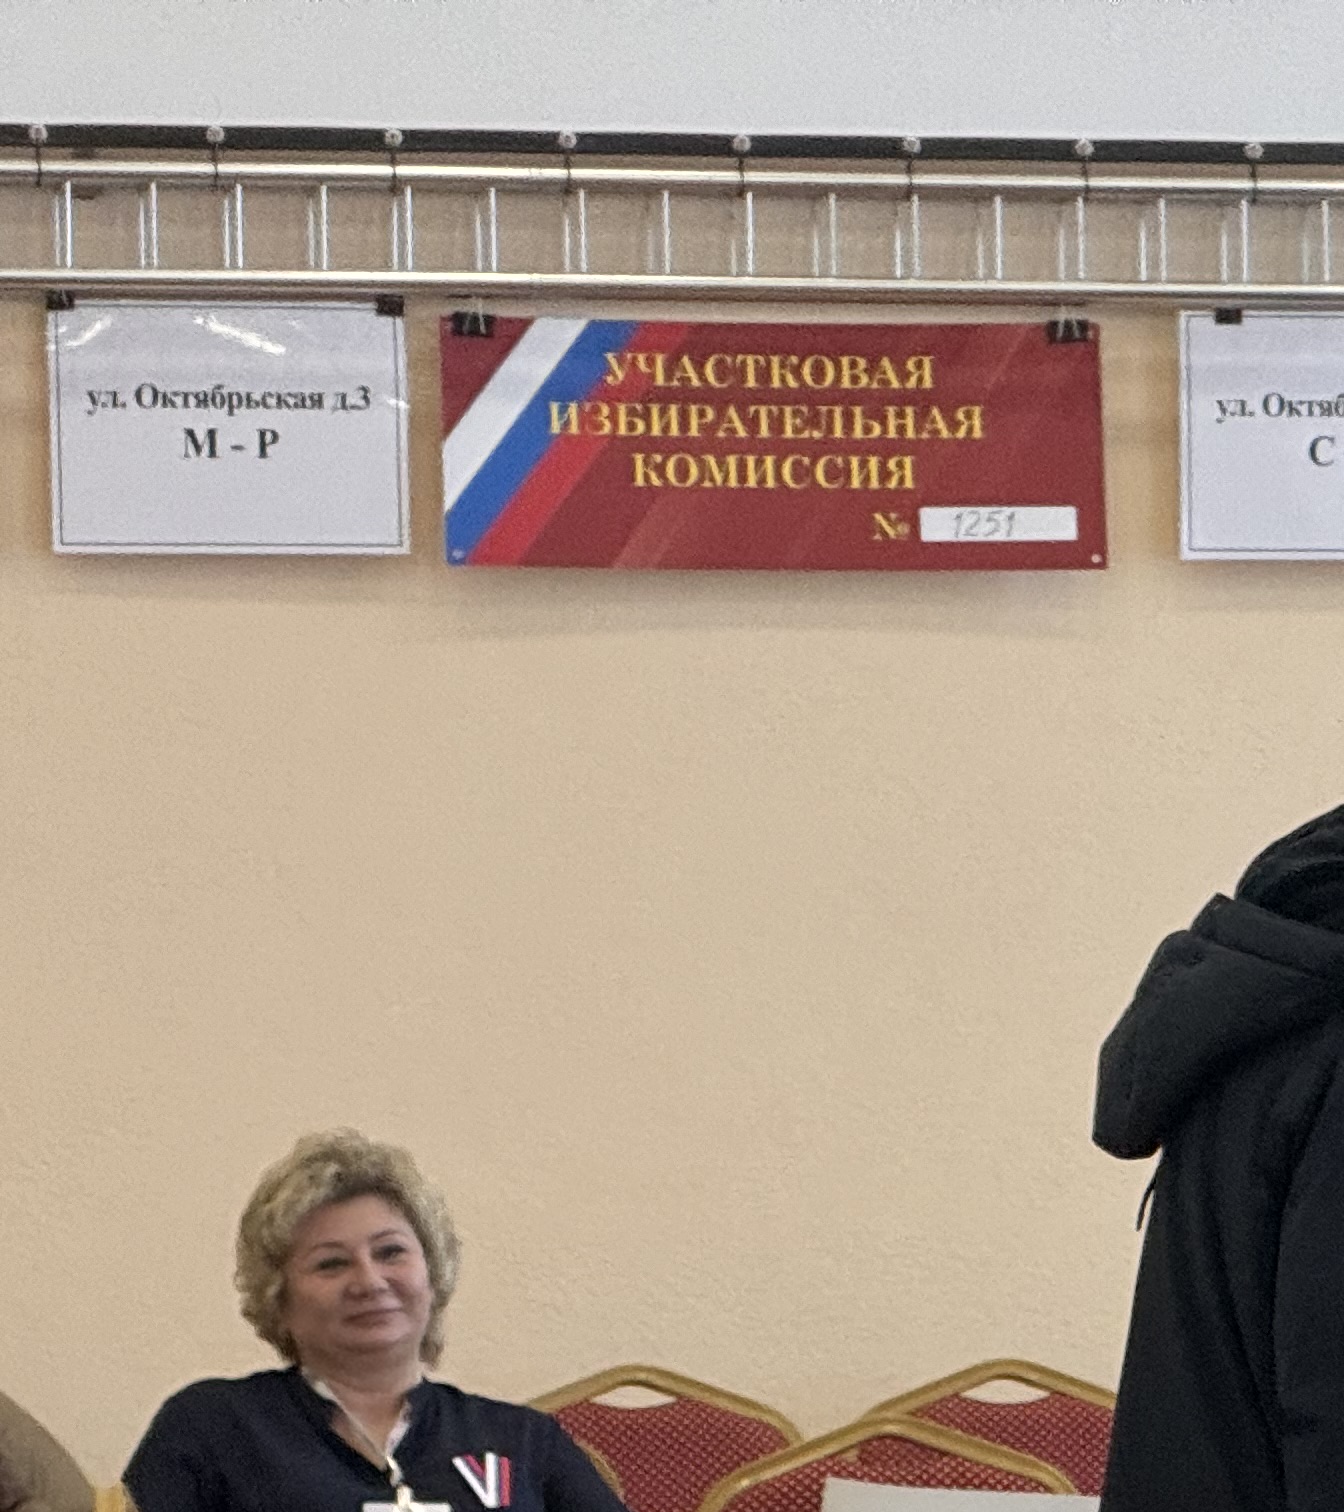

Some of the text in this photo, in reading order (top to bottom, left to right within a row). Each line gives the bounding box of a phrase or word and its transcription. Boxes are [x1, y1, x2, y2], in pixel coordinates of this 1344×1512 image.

[604, 352, 935, 390] УЧАСТКОВАЯ
[86, 390, 127, 416] ул.
[134, 383, 325, 416] Октябрьская
[1216, 400, 1254, 424] ул.
[549, 401, 986, 439] ИЗБИРАТЕЛЬНАЯ
[183, 427, 221, 459] М
[257, 428, 280, 459] Р
[1309, 435, 1335, 467] С
[631, 453, 916, 490] КОМИССИЯ
[871, 510, 1016, 541] № 1251
